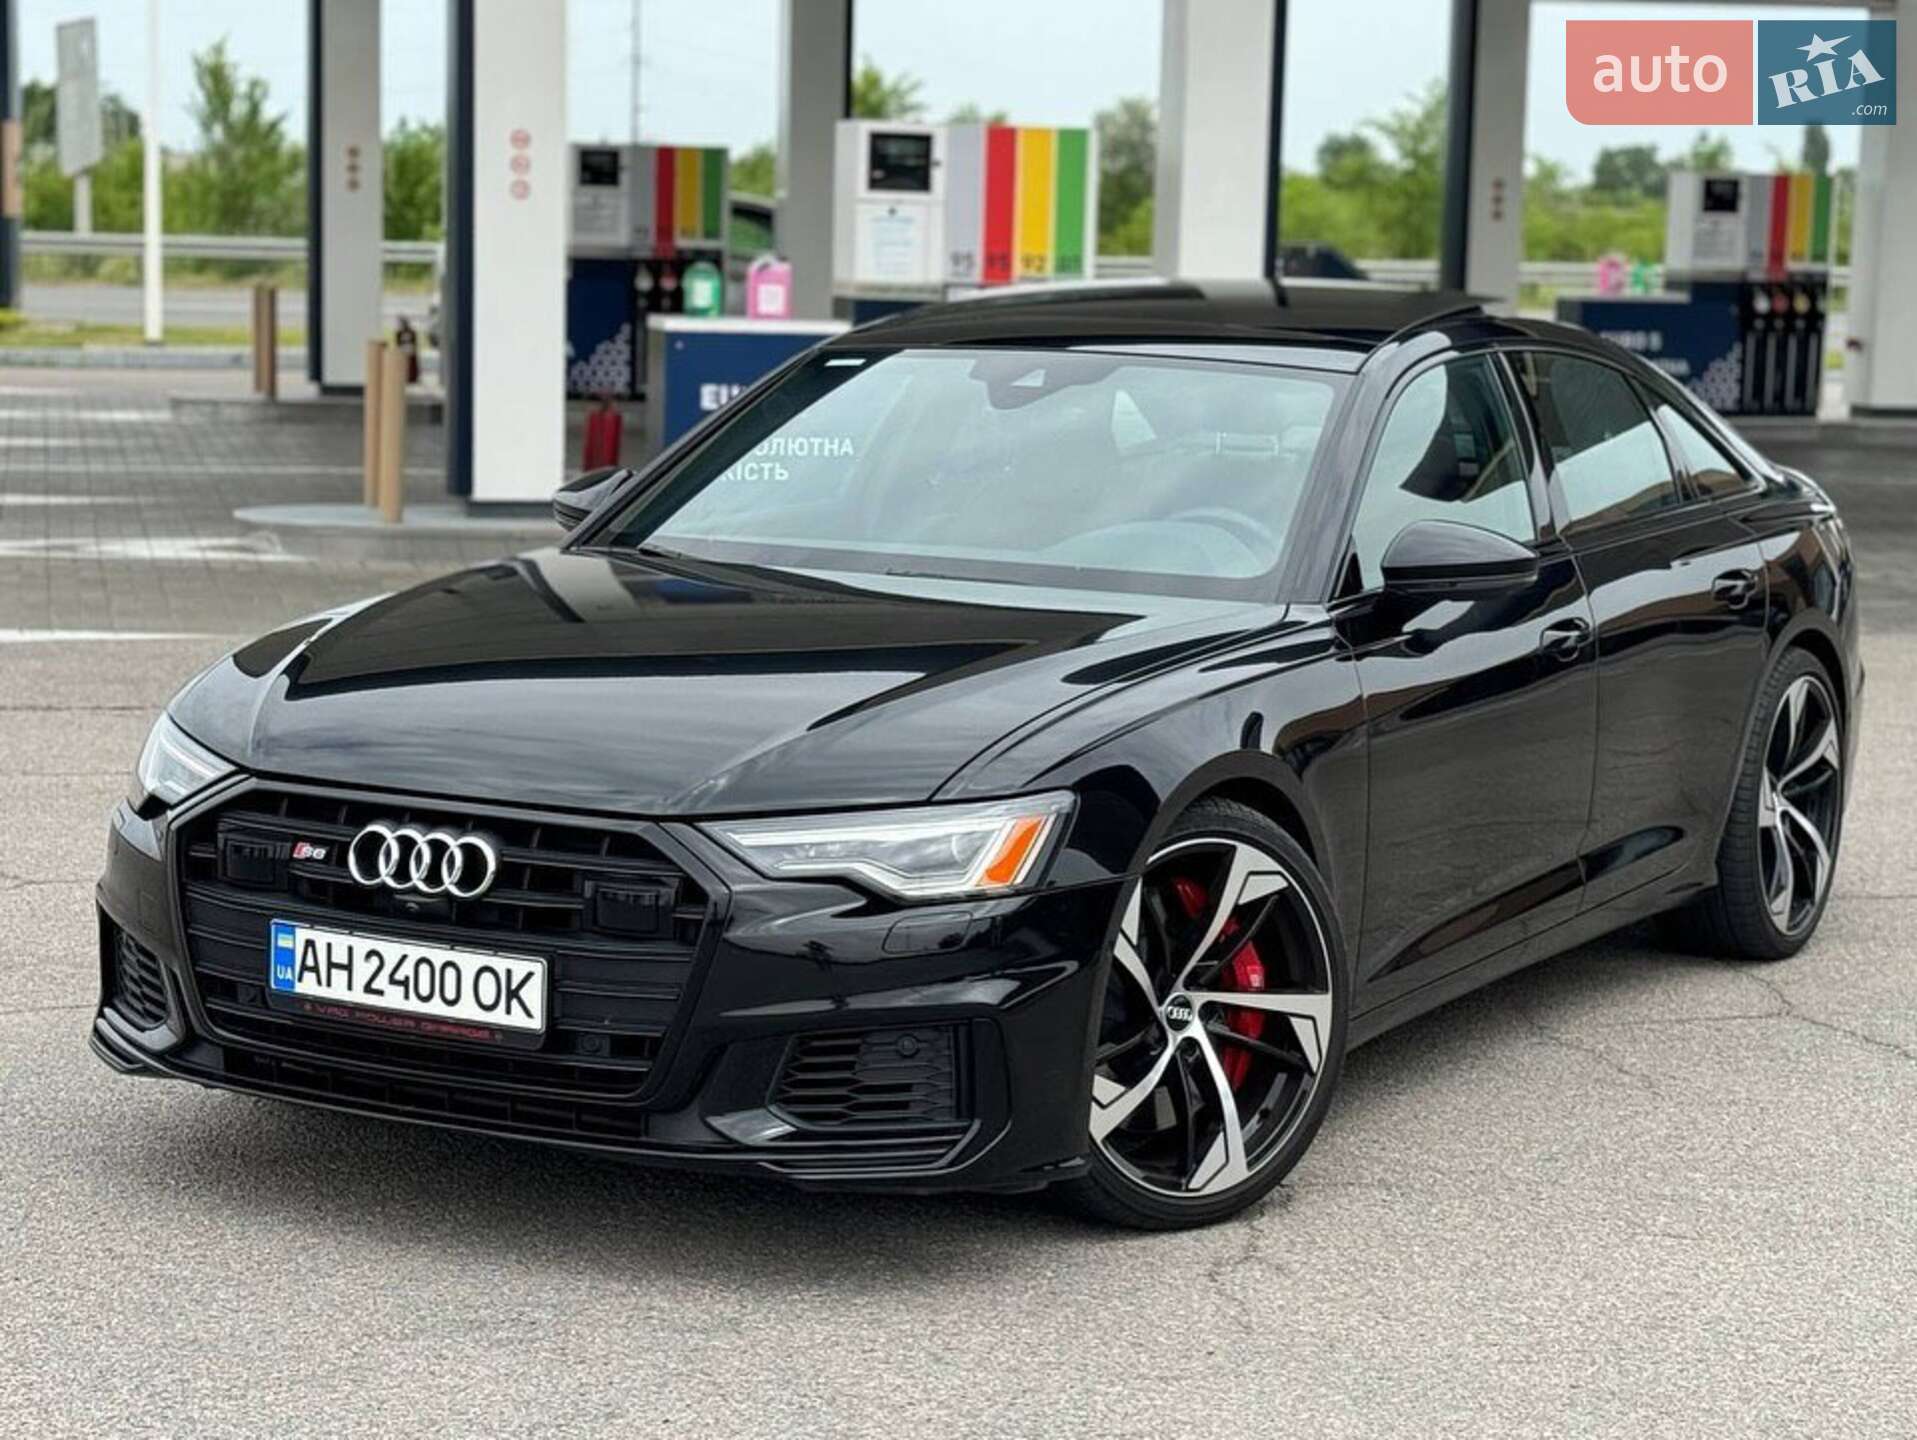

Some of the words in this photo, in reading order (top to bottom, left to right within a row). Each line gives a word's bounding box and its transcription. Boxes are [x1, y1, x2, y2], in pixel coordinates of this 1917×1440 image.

[700, 383, 748, 411] EU
[755, 437, 854, 457] ОЛЮТНА
[720, 462, 789, 481] КІСТЬ
[277, 964, 293, 980] UA
[298, 939, 354, 991] AH
[363, 949, 462, 1007] 2400
[473, 965, 535, 1019] OK
